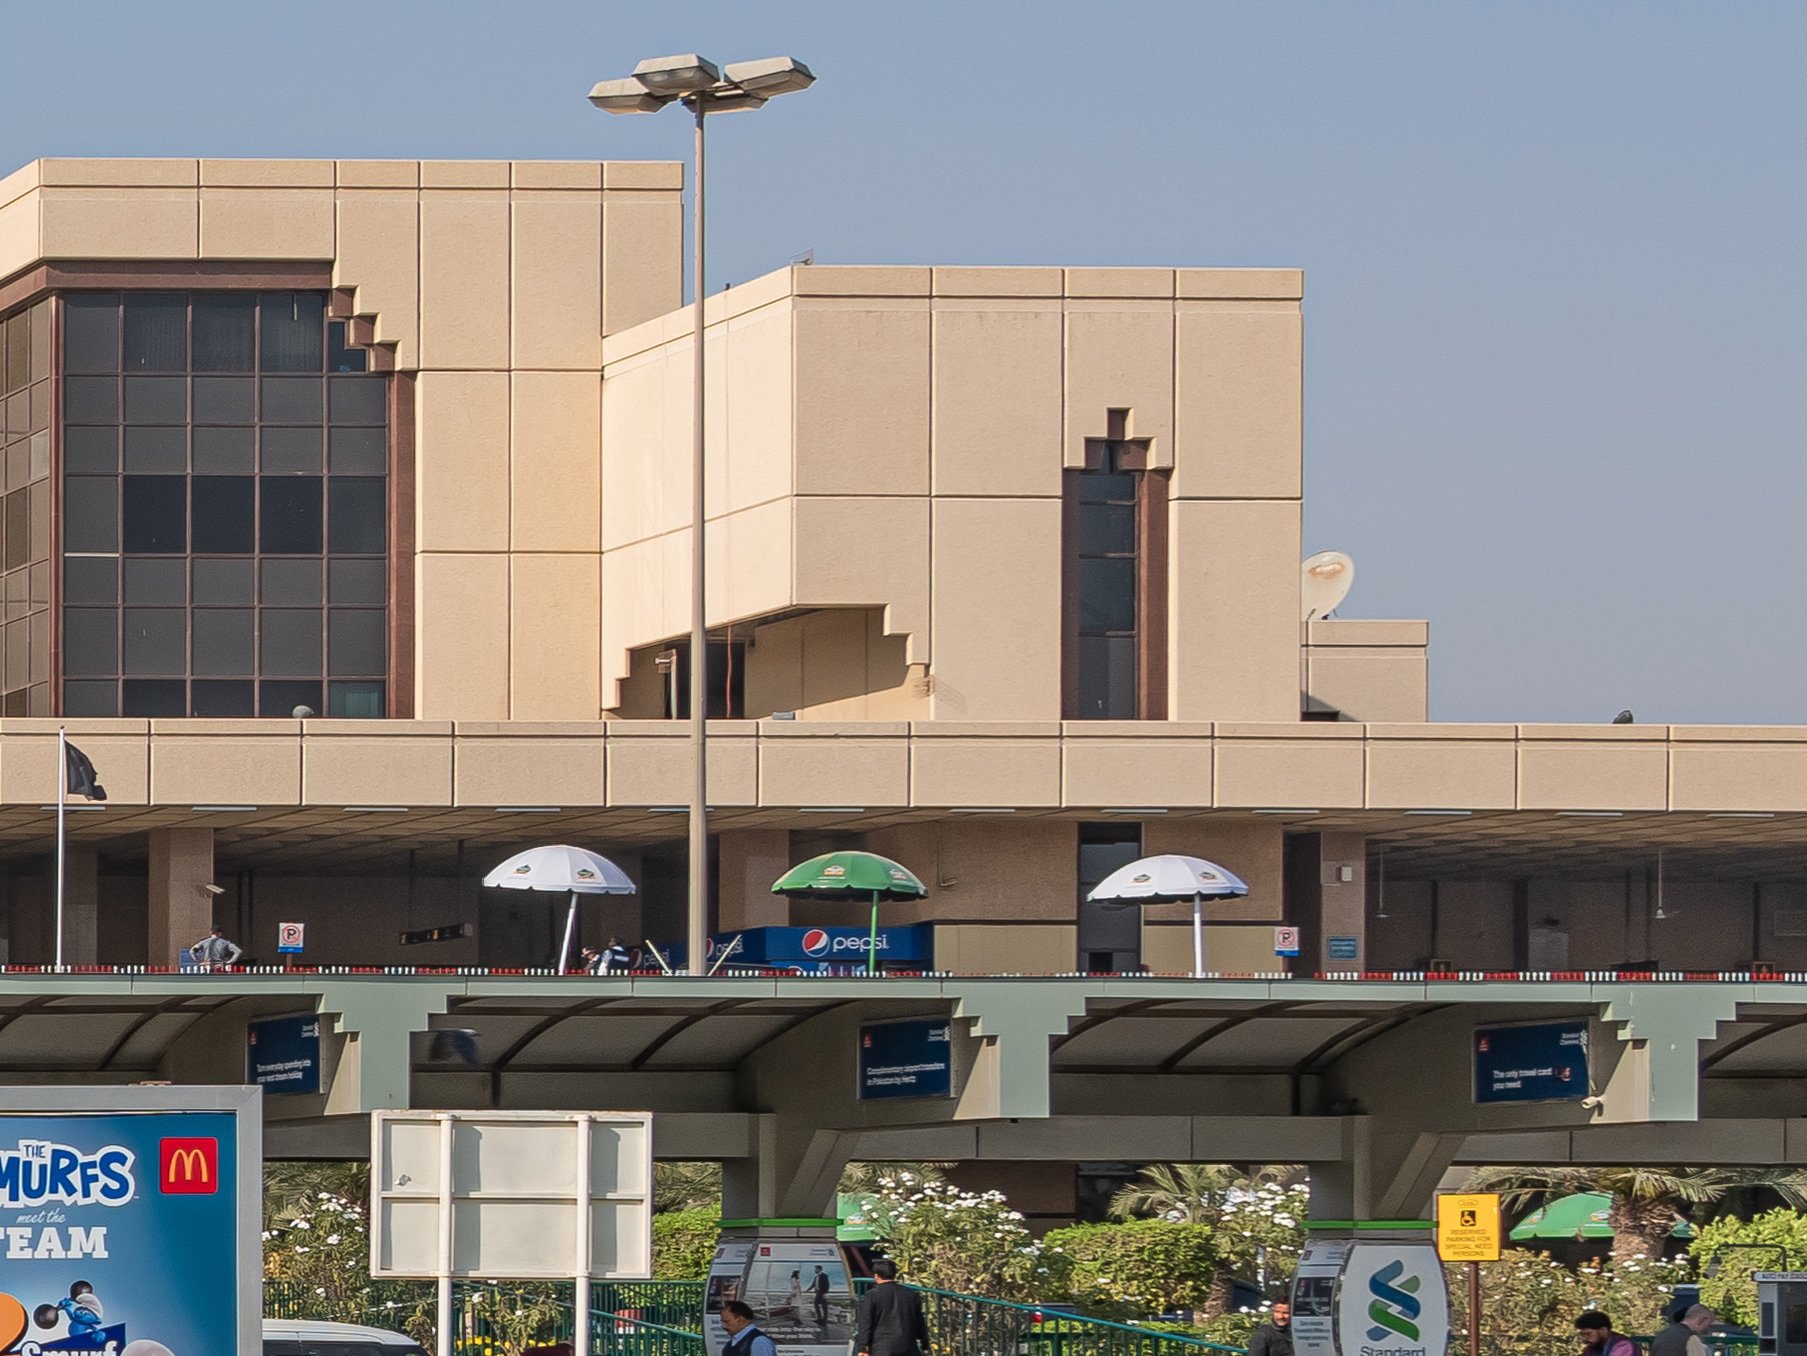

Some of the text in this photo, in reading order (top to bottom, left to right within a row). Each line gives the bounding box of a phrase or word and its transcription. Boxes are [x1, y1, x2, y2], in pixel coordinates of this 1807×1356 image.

[832, 934, 889, 953] pepsi
[23, 1144, 46, 1159] THE
[16, 1207, 67, 1224] meet the
